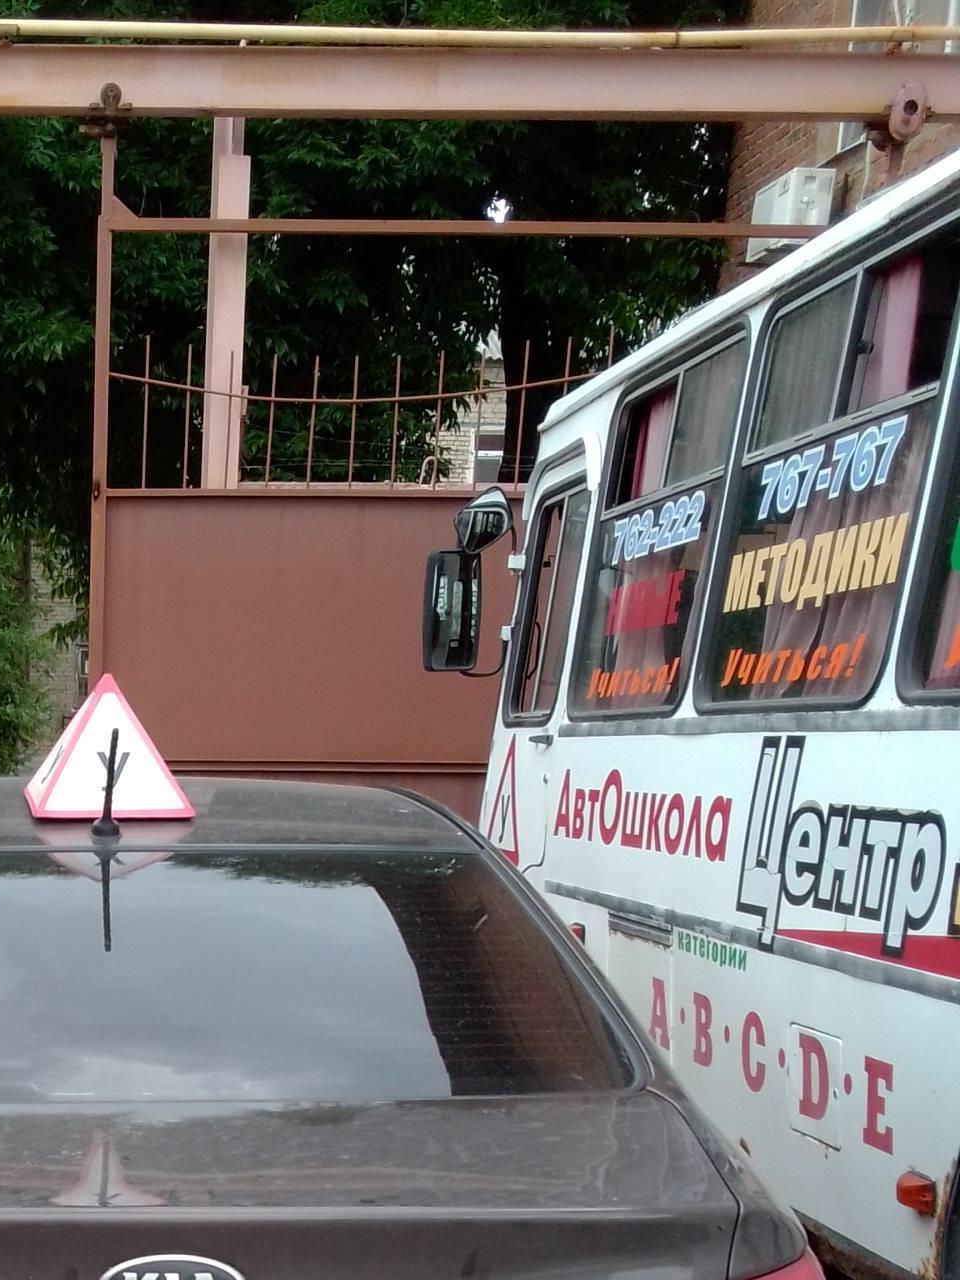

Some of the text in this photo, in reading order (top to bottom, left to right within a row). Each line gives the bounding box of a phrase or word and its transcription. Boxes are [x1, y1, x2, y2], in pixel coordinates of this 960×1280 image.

[757, 415, 908, 521] 767-767
[611, 490, 706, 567] 762-222
[722, 512, 909, 614] МЕТОДИКИ
[735, 735, 947, 960] Центр
[676, 930, 749, 973] категории
